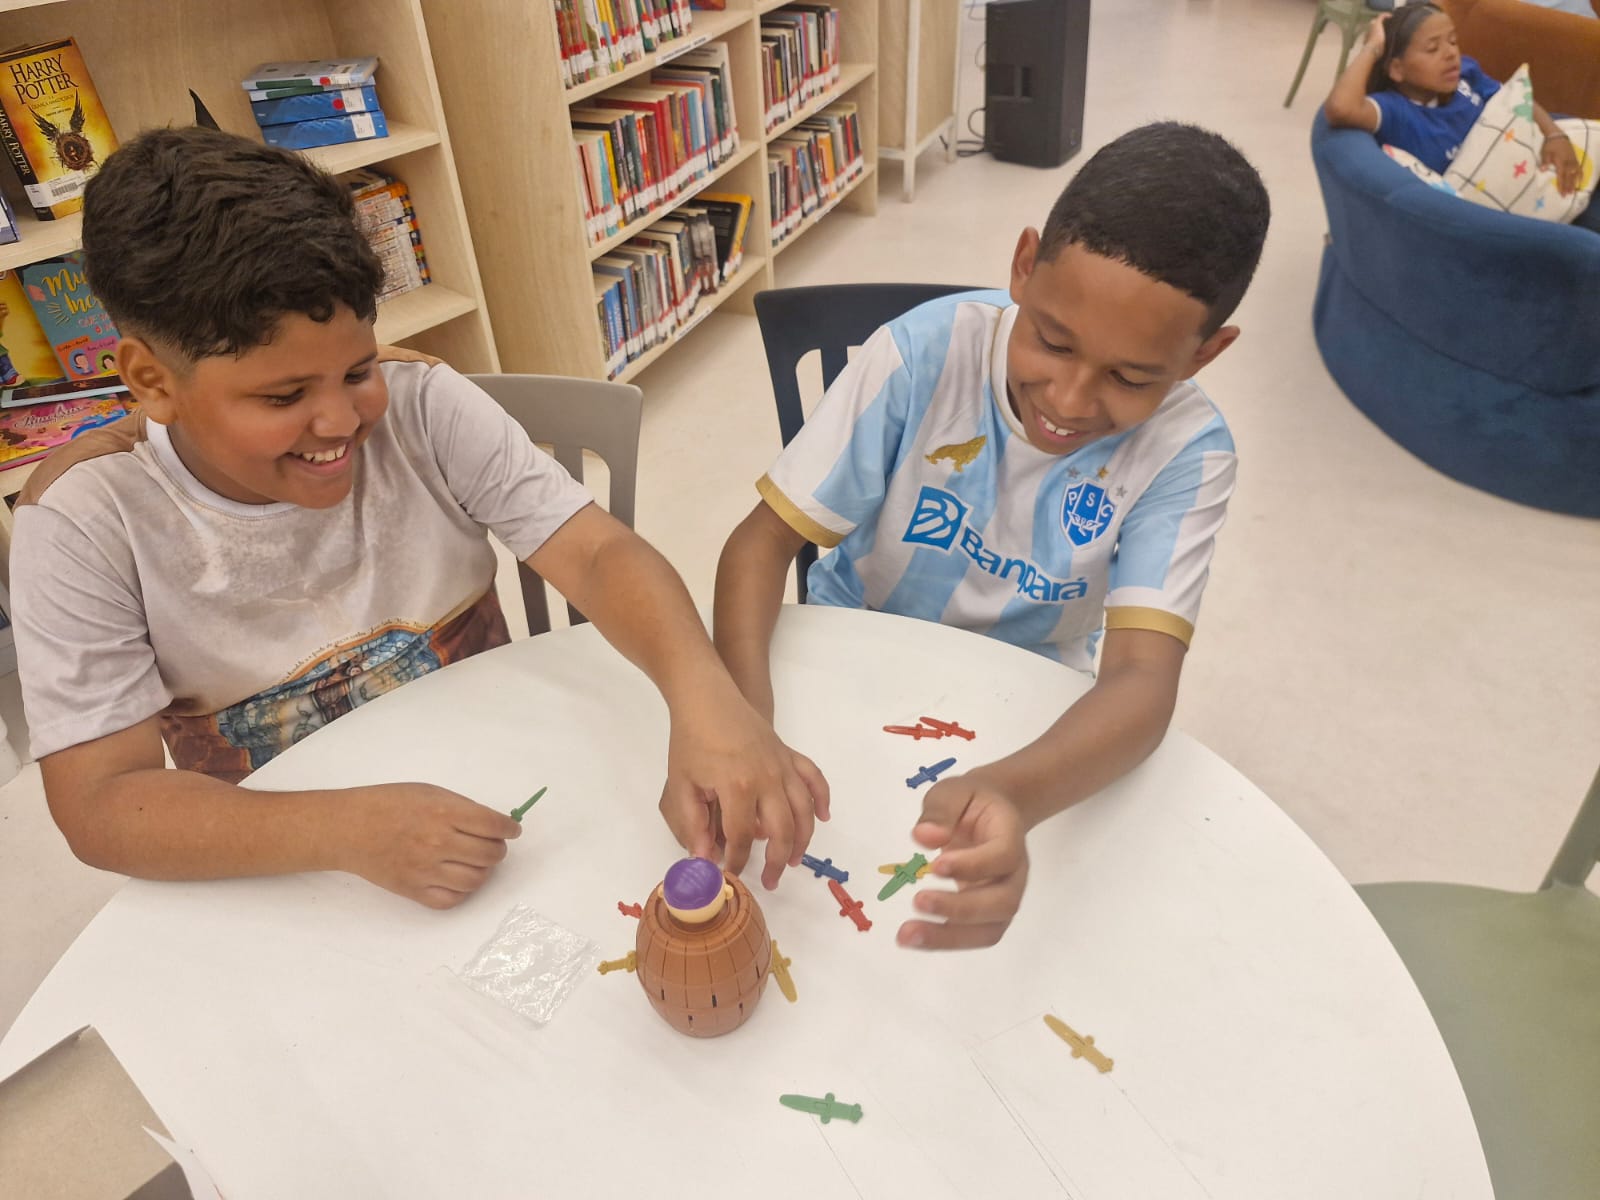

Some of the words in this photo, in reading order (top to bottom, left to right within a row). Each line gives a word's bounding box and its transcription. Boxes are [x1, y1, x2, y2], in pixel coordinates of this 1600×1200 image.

[8, 54, 64, 83] HARRY
[12, 73, 79, 104] POTTER
[0, 109, 16, 140] HARRY
[9, 142, 31, 175] POTTER
[960, 526, 1087, 601] Banpará
